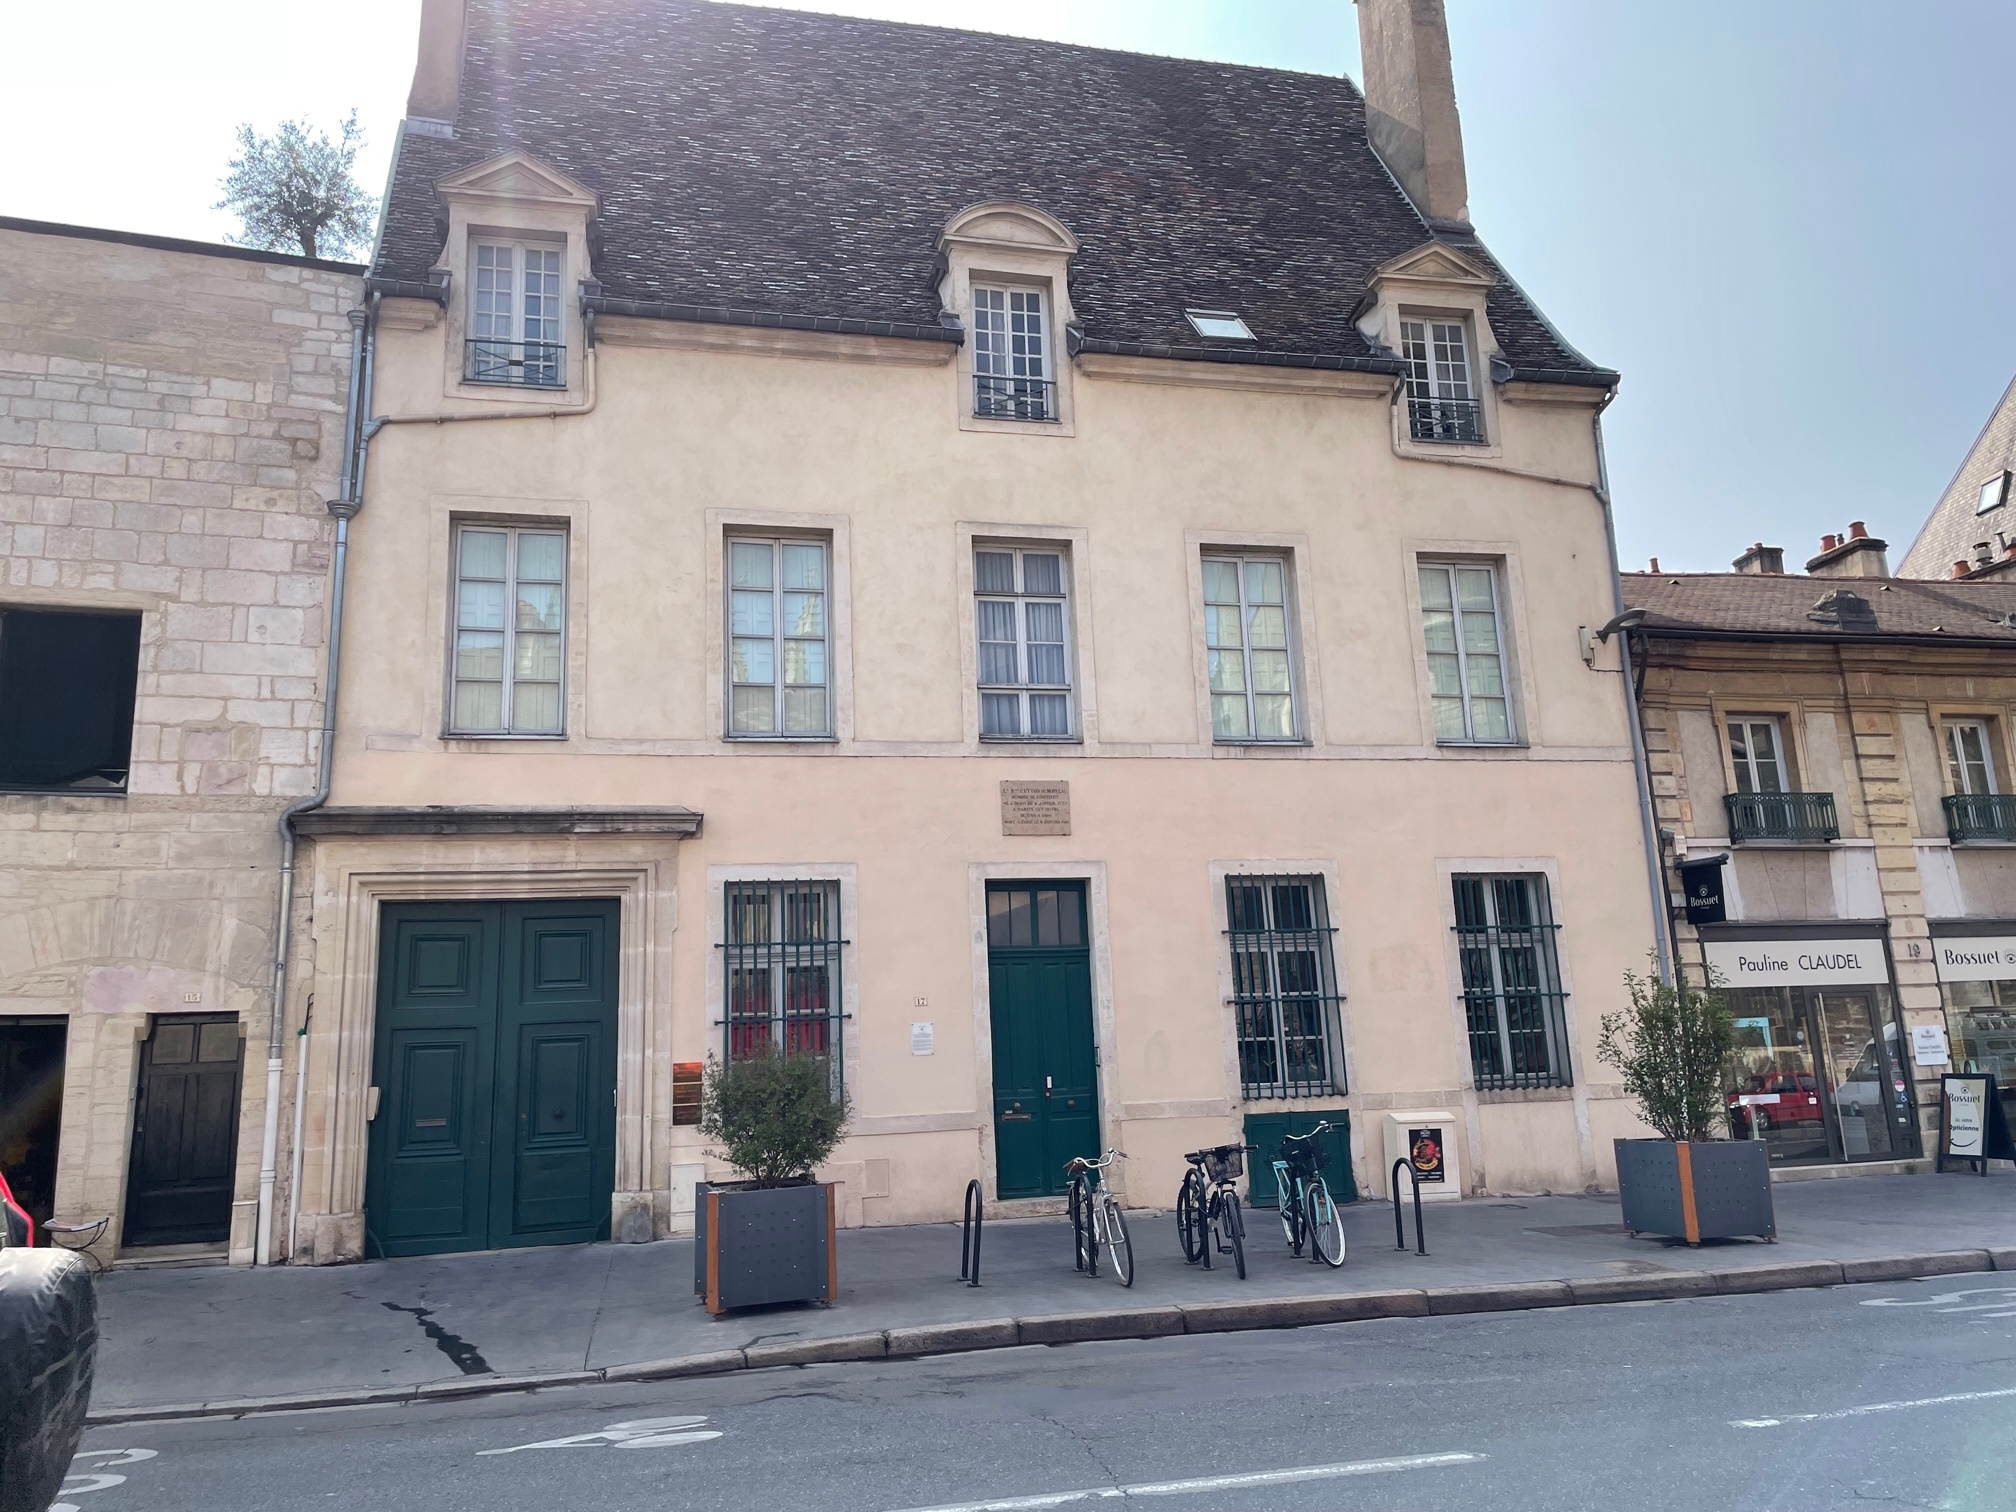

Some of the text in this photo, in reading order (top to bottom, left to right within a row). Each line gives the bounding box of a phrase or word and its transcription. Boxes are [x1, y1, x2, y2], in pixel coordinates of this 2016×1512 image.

[1690, 895, 1719, 907] Bossuet
[1907, 943, 1920, 957] 19
[1738, 954, 1862, 971] Pauline CLAUDEL
[1944, 949, 2001, 965] Bossuet
[917, 997, 926, 1005] 17
[1948, 1092, 1981, 1103] Bossuet
